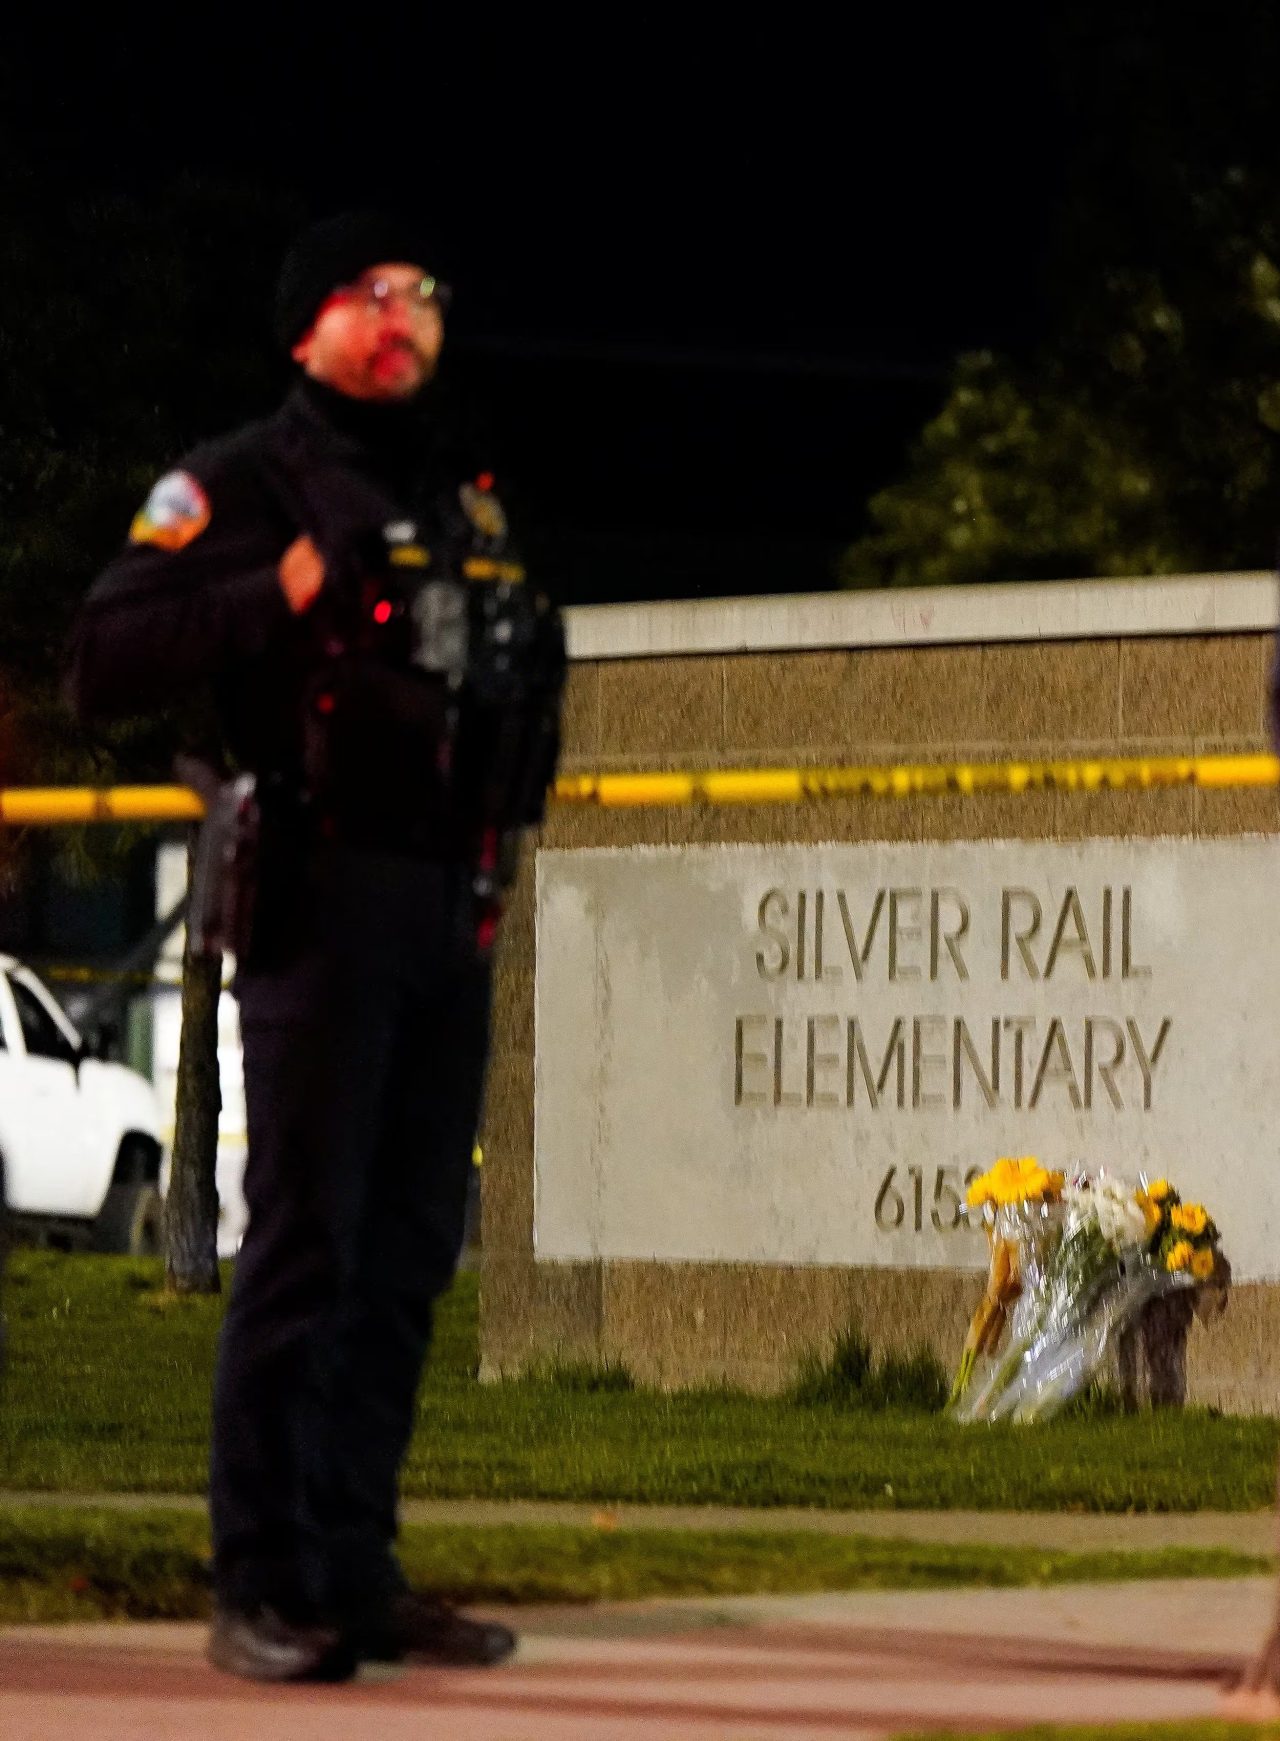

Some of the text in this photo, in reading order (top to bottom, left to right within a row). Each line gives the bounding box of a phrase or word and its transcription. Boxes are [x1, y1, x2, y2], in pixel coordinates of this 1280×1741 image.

[756, 884, 1153, 982] SILVER RAIL
[734, 1014, 1173, 1110] ELEMENTARY
